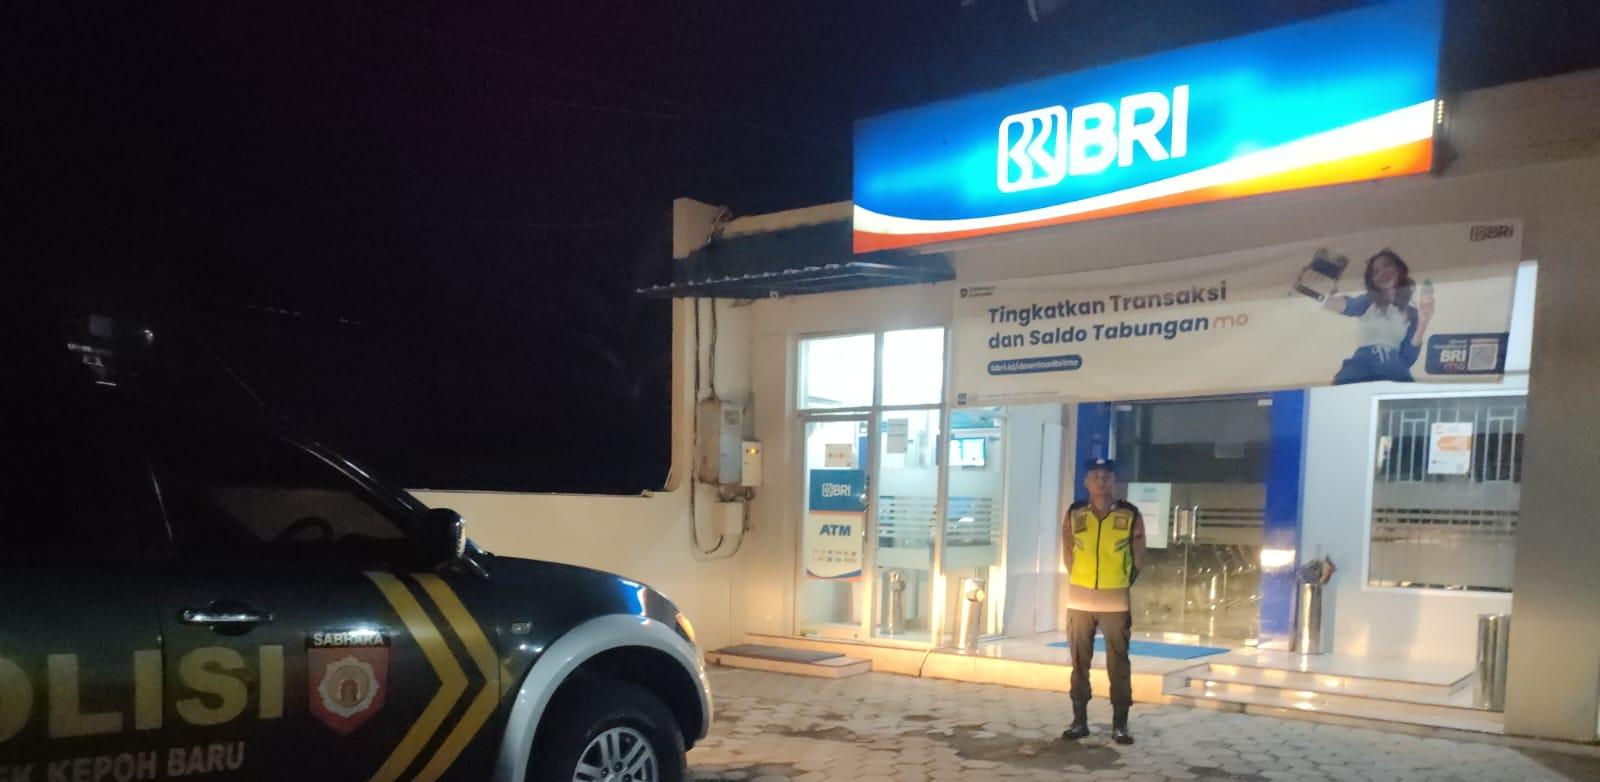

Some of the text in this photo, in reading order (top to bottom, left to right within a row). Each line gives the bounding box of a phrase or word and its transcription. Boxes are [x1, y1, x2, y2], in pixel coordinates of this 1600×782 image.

[1069, 85, 1188, 176] BRI
[1487, 225, 1514, 239] BRI
[988, 281, 1227, 327] Tingkatkan Transaksi
[988, 332, 1025, 349] dan
[1029, 327, 1088, 346] Saldo
[1092, 316, 1209, 340] Tabungan
[1440, 349, 1467, 363] BRI
[833, 484, 851, 497] BRI
[820, 524, 851, 536] ATM
[313, 631, 384, 647] SABHARA
[48, 750, 157, 782] KEPOH
[167, 741, 245, 776] BARU
